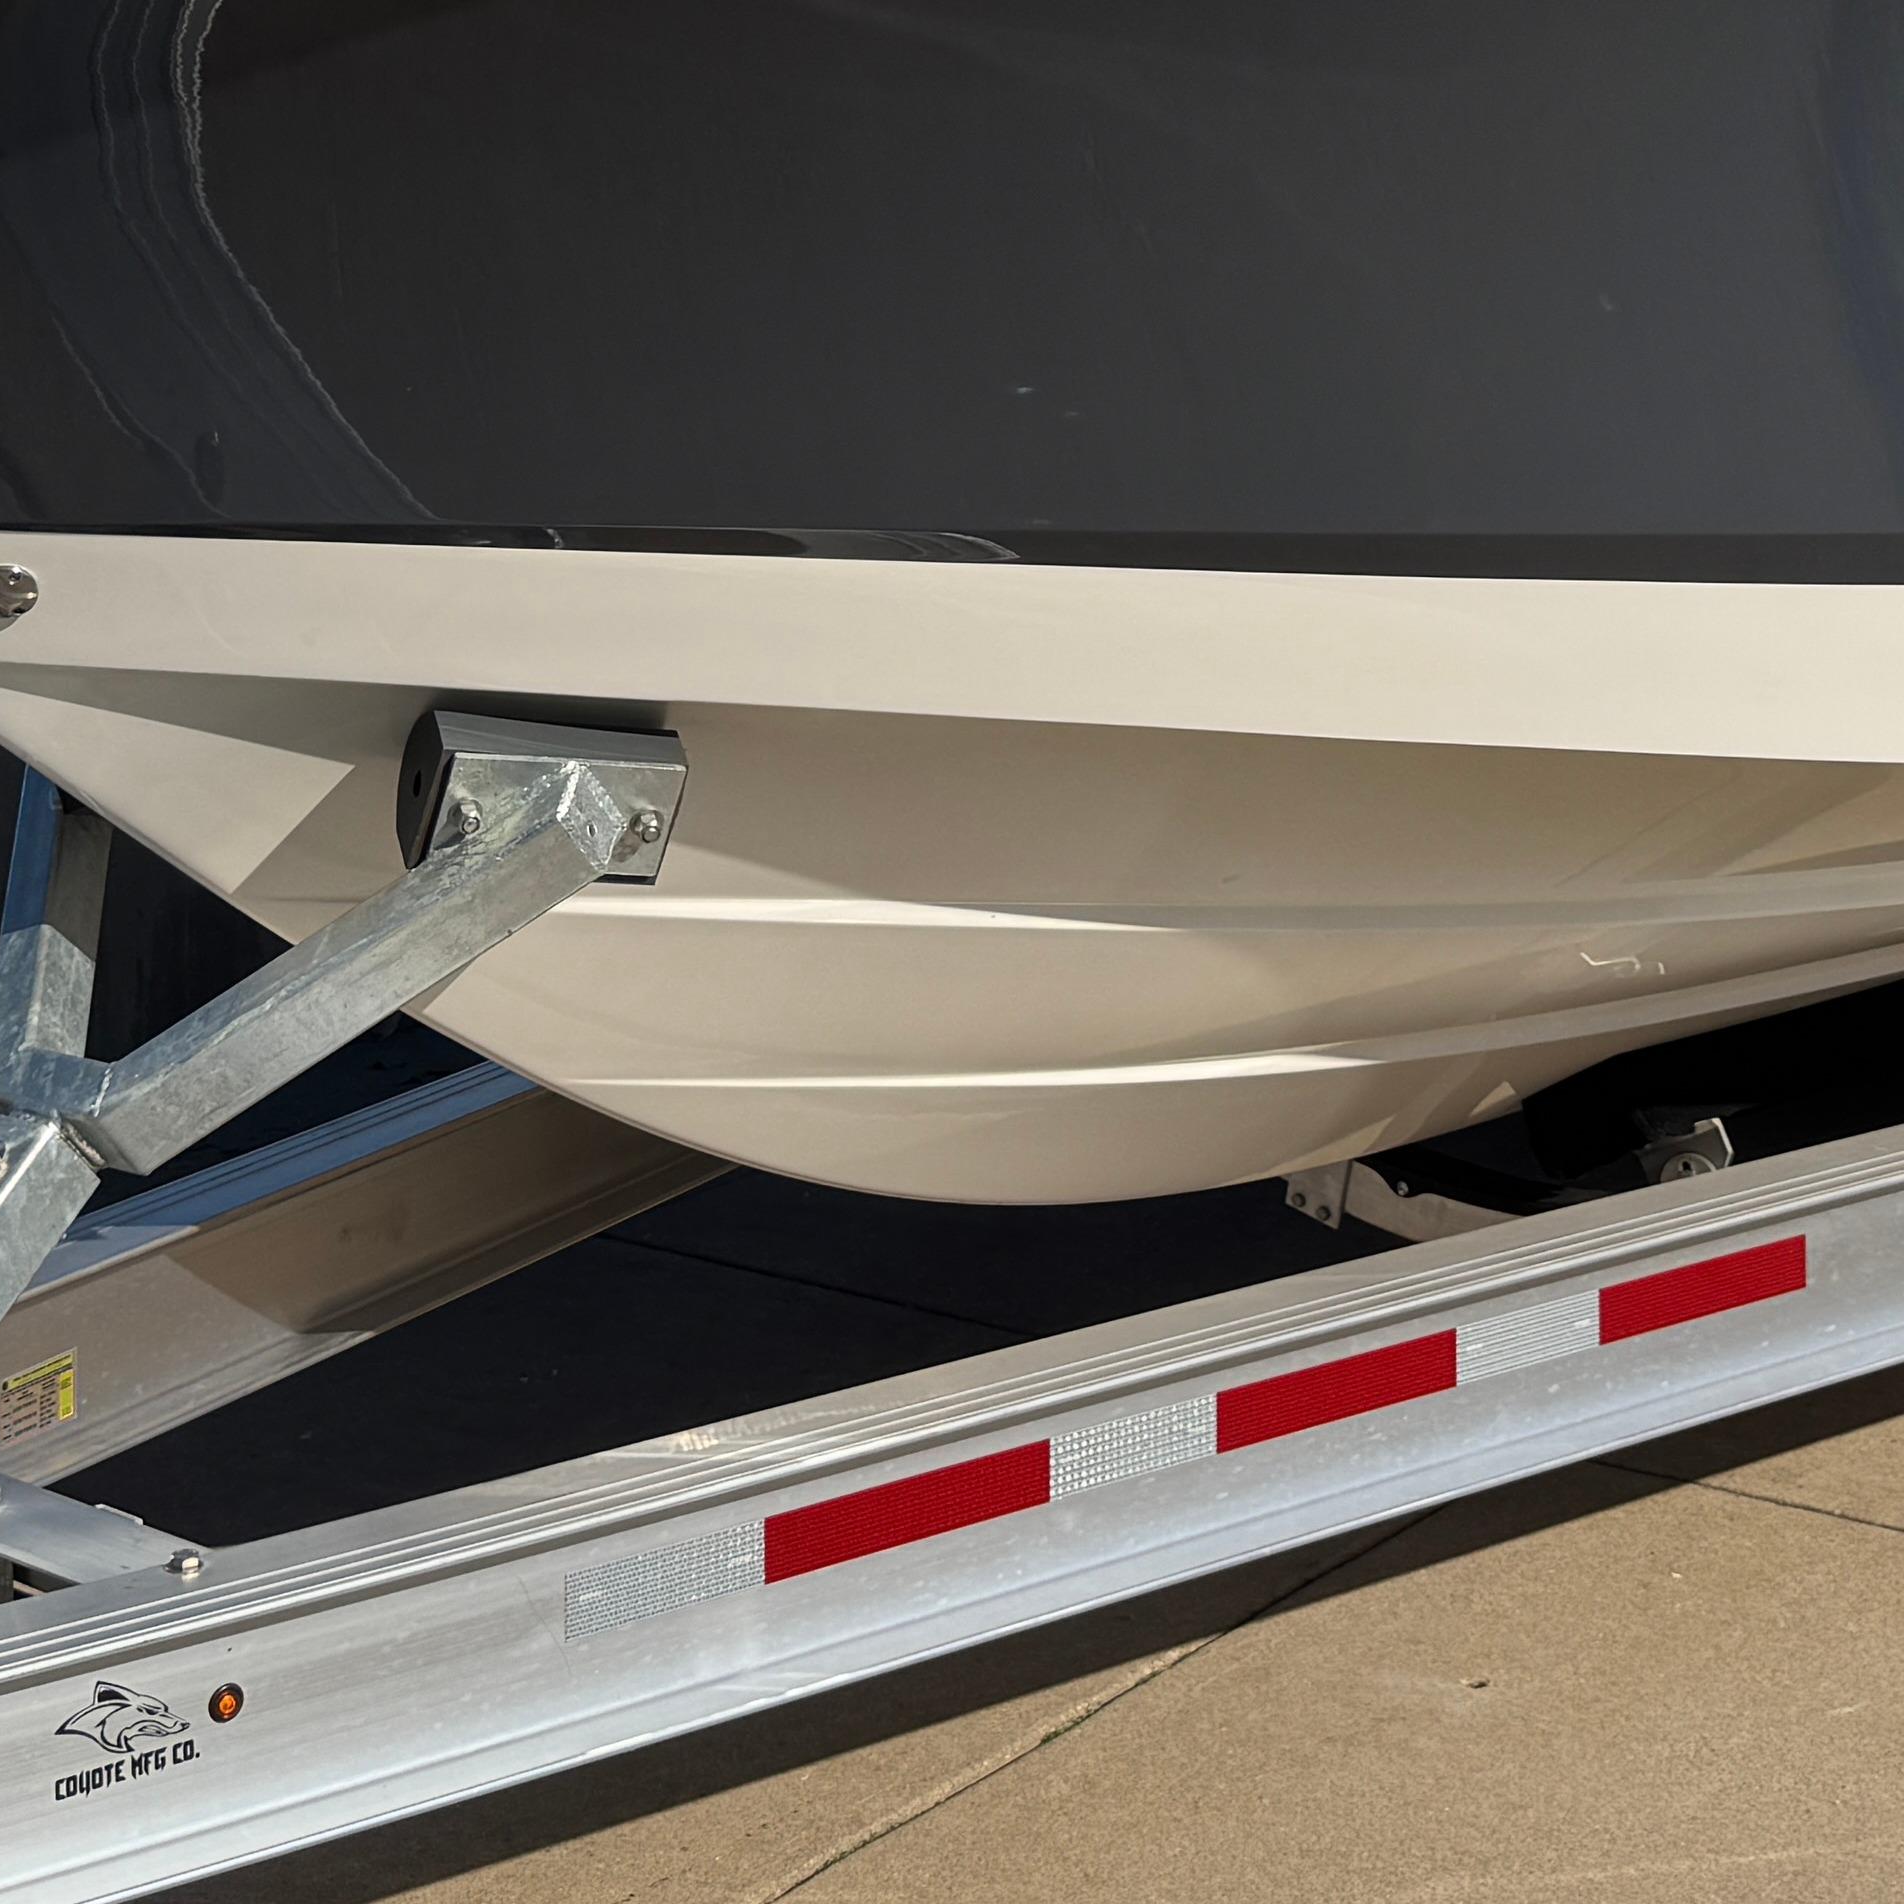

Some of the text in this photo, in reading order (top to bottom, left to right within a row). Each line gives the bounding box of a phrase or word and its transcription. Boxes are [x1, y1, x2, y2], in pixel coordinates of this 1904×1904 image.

[55, 1739, 200, 1801] COYOTE MFG CO.
